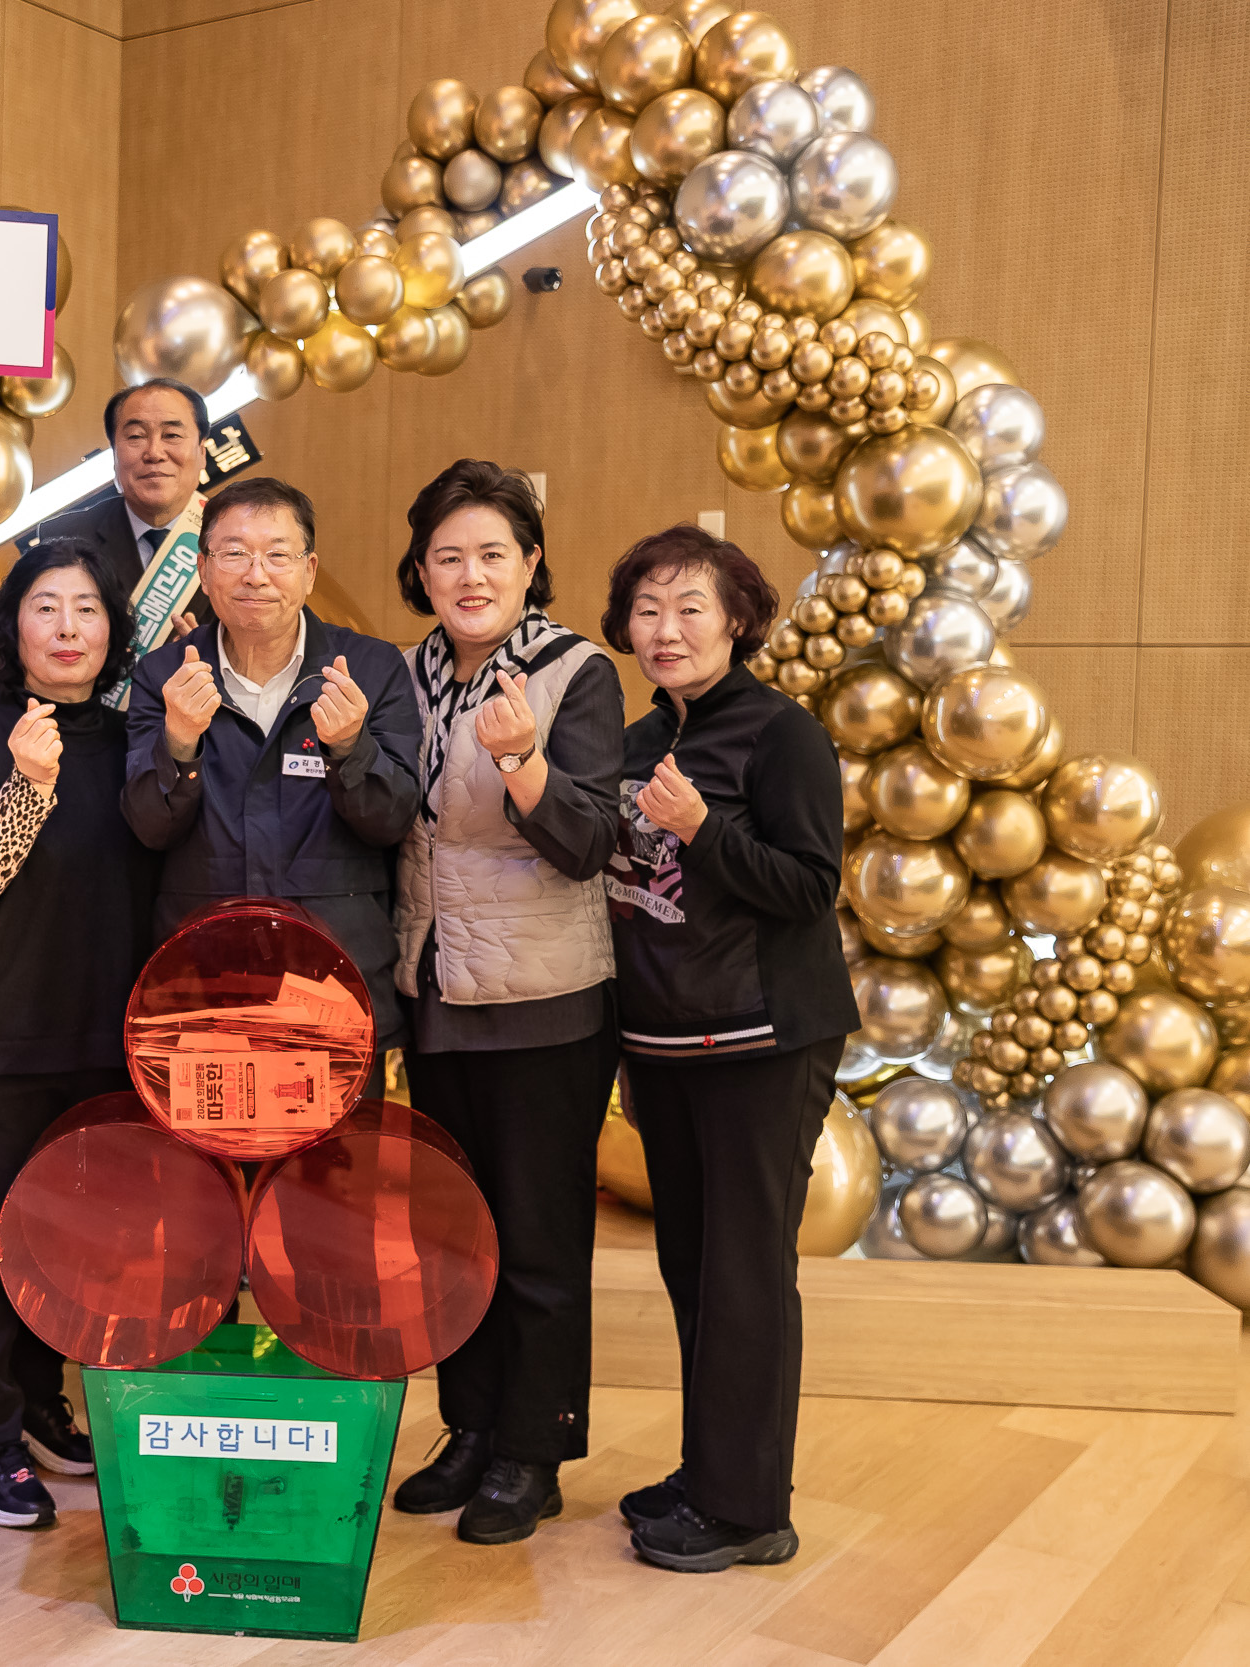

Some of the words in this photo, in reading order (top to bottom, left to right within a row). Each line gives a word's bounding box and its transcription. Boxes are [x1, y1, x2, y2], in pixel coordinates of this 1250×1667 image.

[197, 1098, 205, 1120] 2026
[205, 1063, 223, 1121] 따뜻한
[224, 1063, 237, 1120] 겨울나기
[145, 1421, 330, 1452] 감사합니다!
